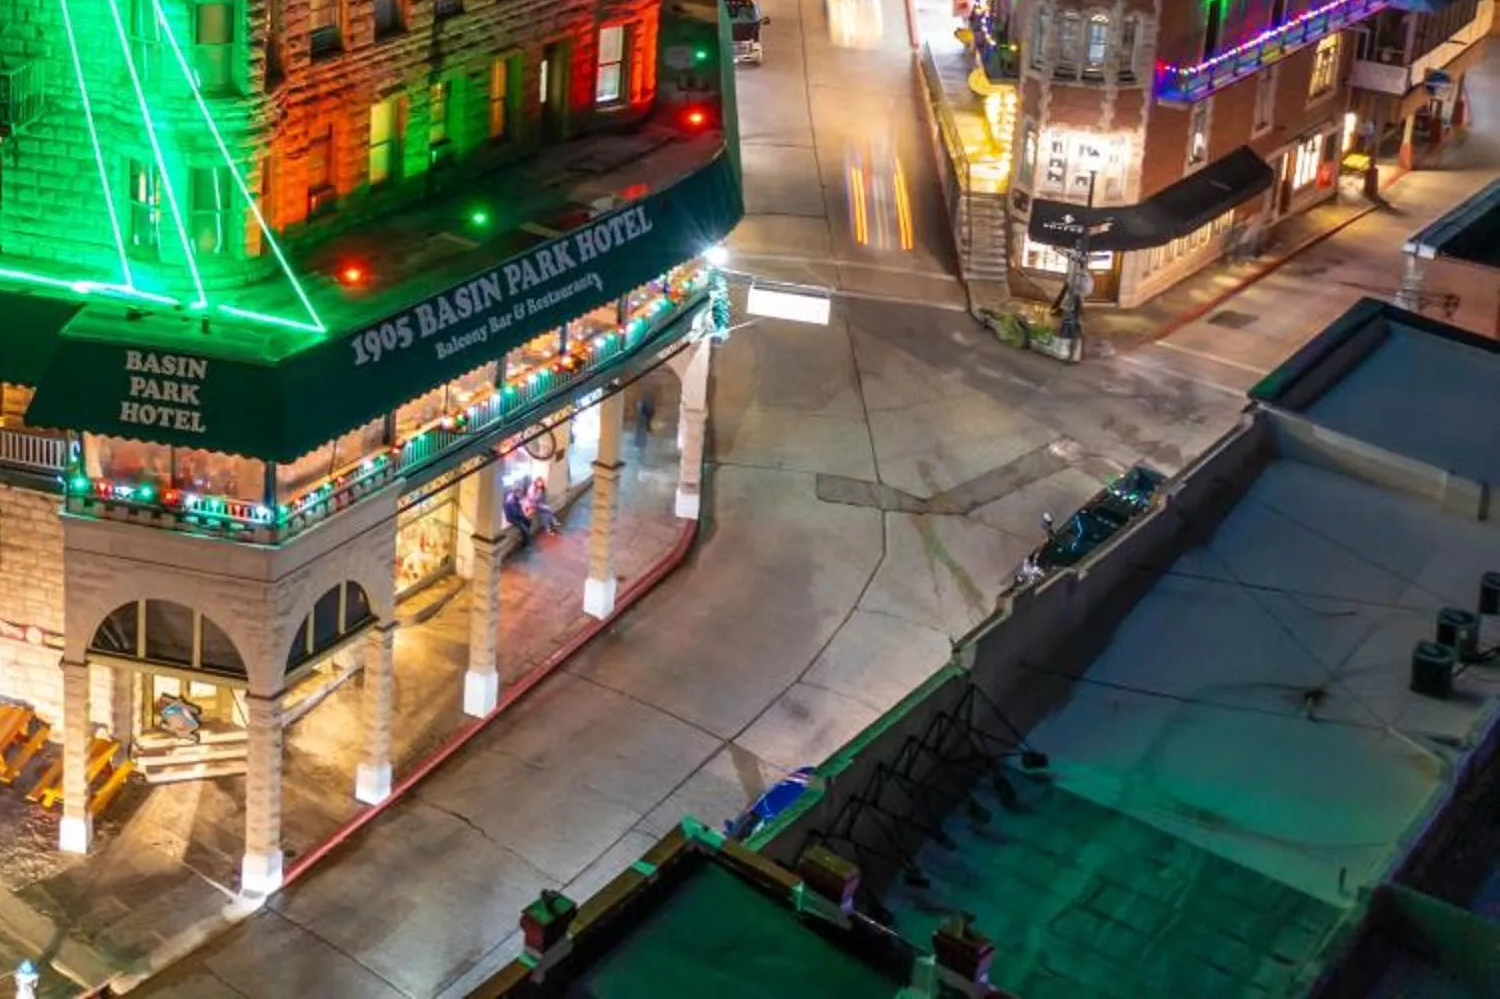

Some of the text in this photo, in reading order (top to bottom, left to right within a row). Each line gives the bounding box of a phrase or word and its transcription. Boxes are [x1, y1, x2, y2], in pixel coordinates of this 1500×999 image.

[352, 205, 652, 365] 1905 BASIN PARK HOTEL
[435, 325, 488, 359] Balcony
[489, 312, 513, 333] Bar
[126, 350, 208, 379] BASIN
[129, 376, 200, 405] PARK
[120, 401, 207, 433] HOTEL
